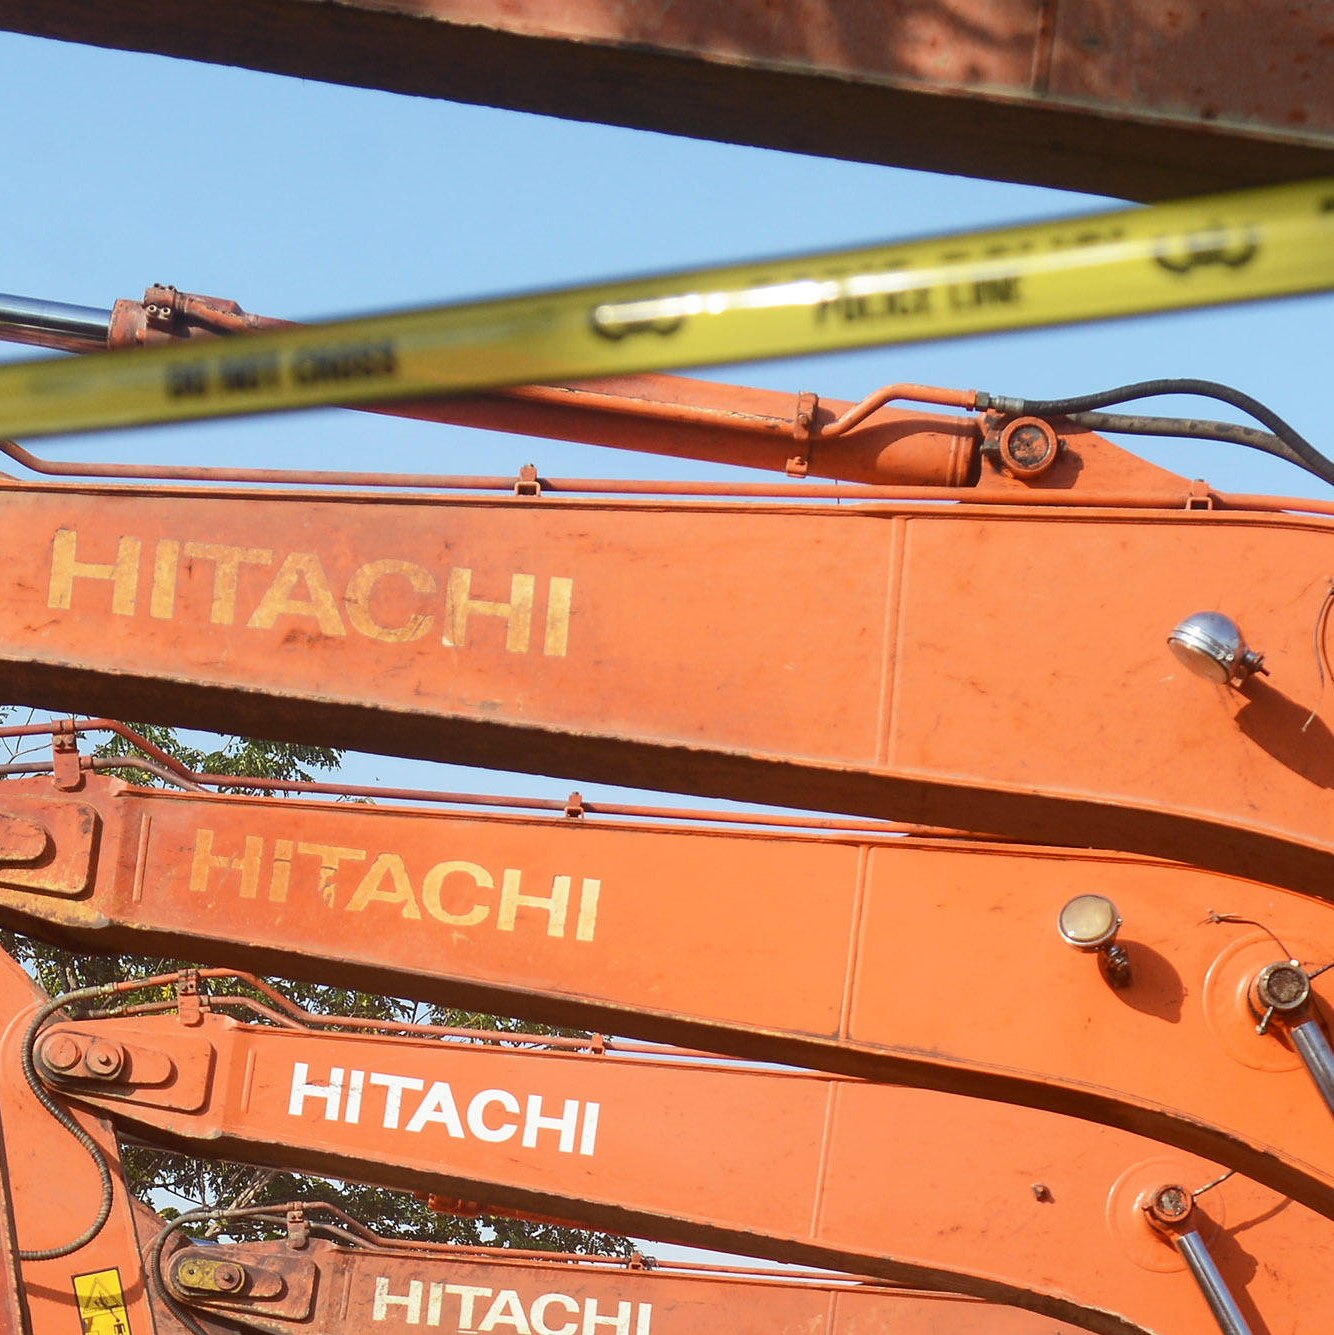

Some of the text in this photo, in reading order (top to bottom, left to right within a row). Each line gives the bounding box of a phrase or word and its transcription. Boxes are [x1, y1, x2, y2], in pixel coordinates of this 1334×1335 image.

[47, 527, 574, 657] HITACHI
[189, 828, 601, 942] HITACHI
[288, 1061, 600, 1156] HITACHI
